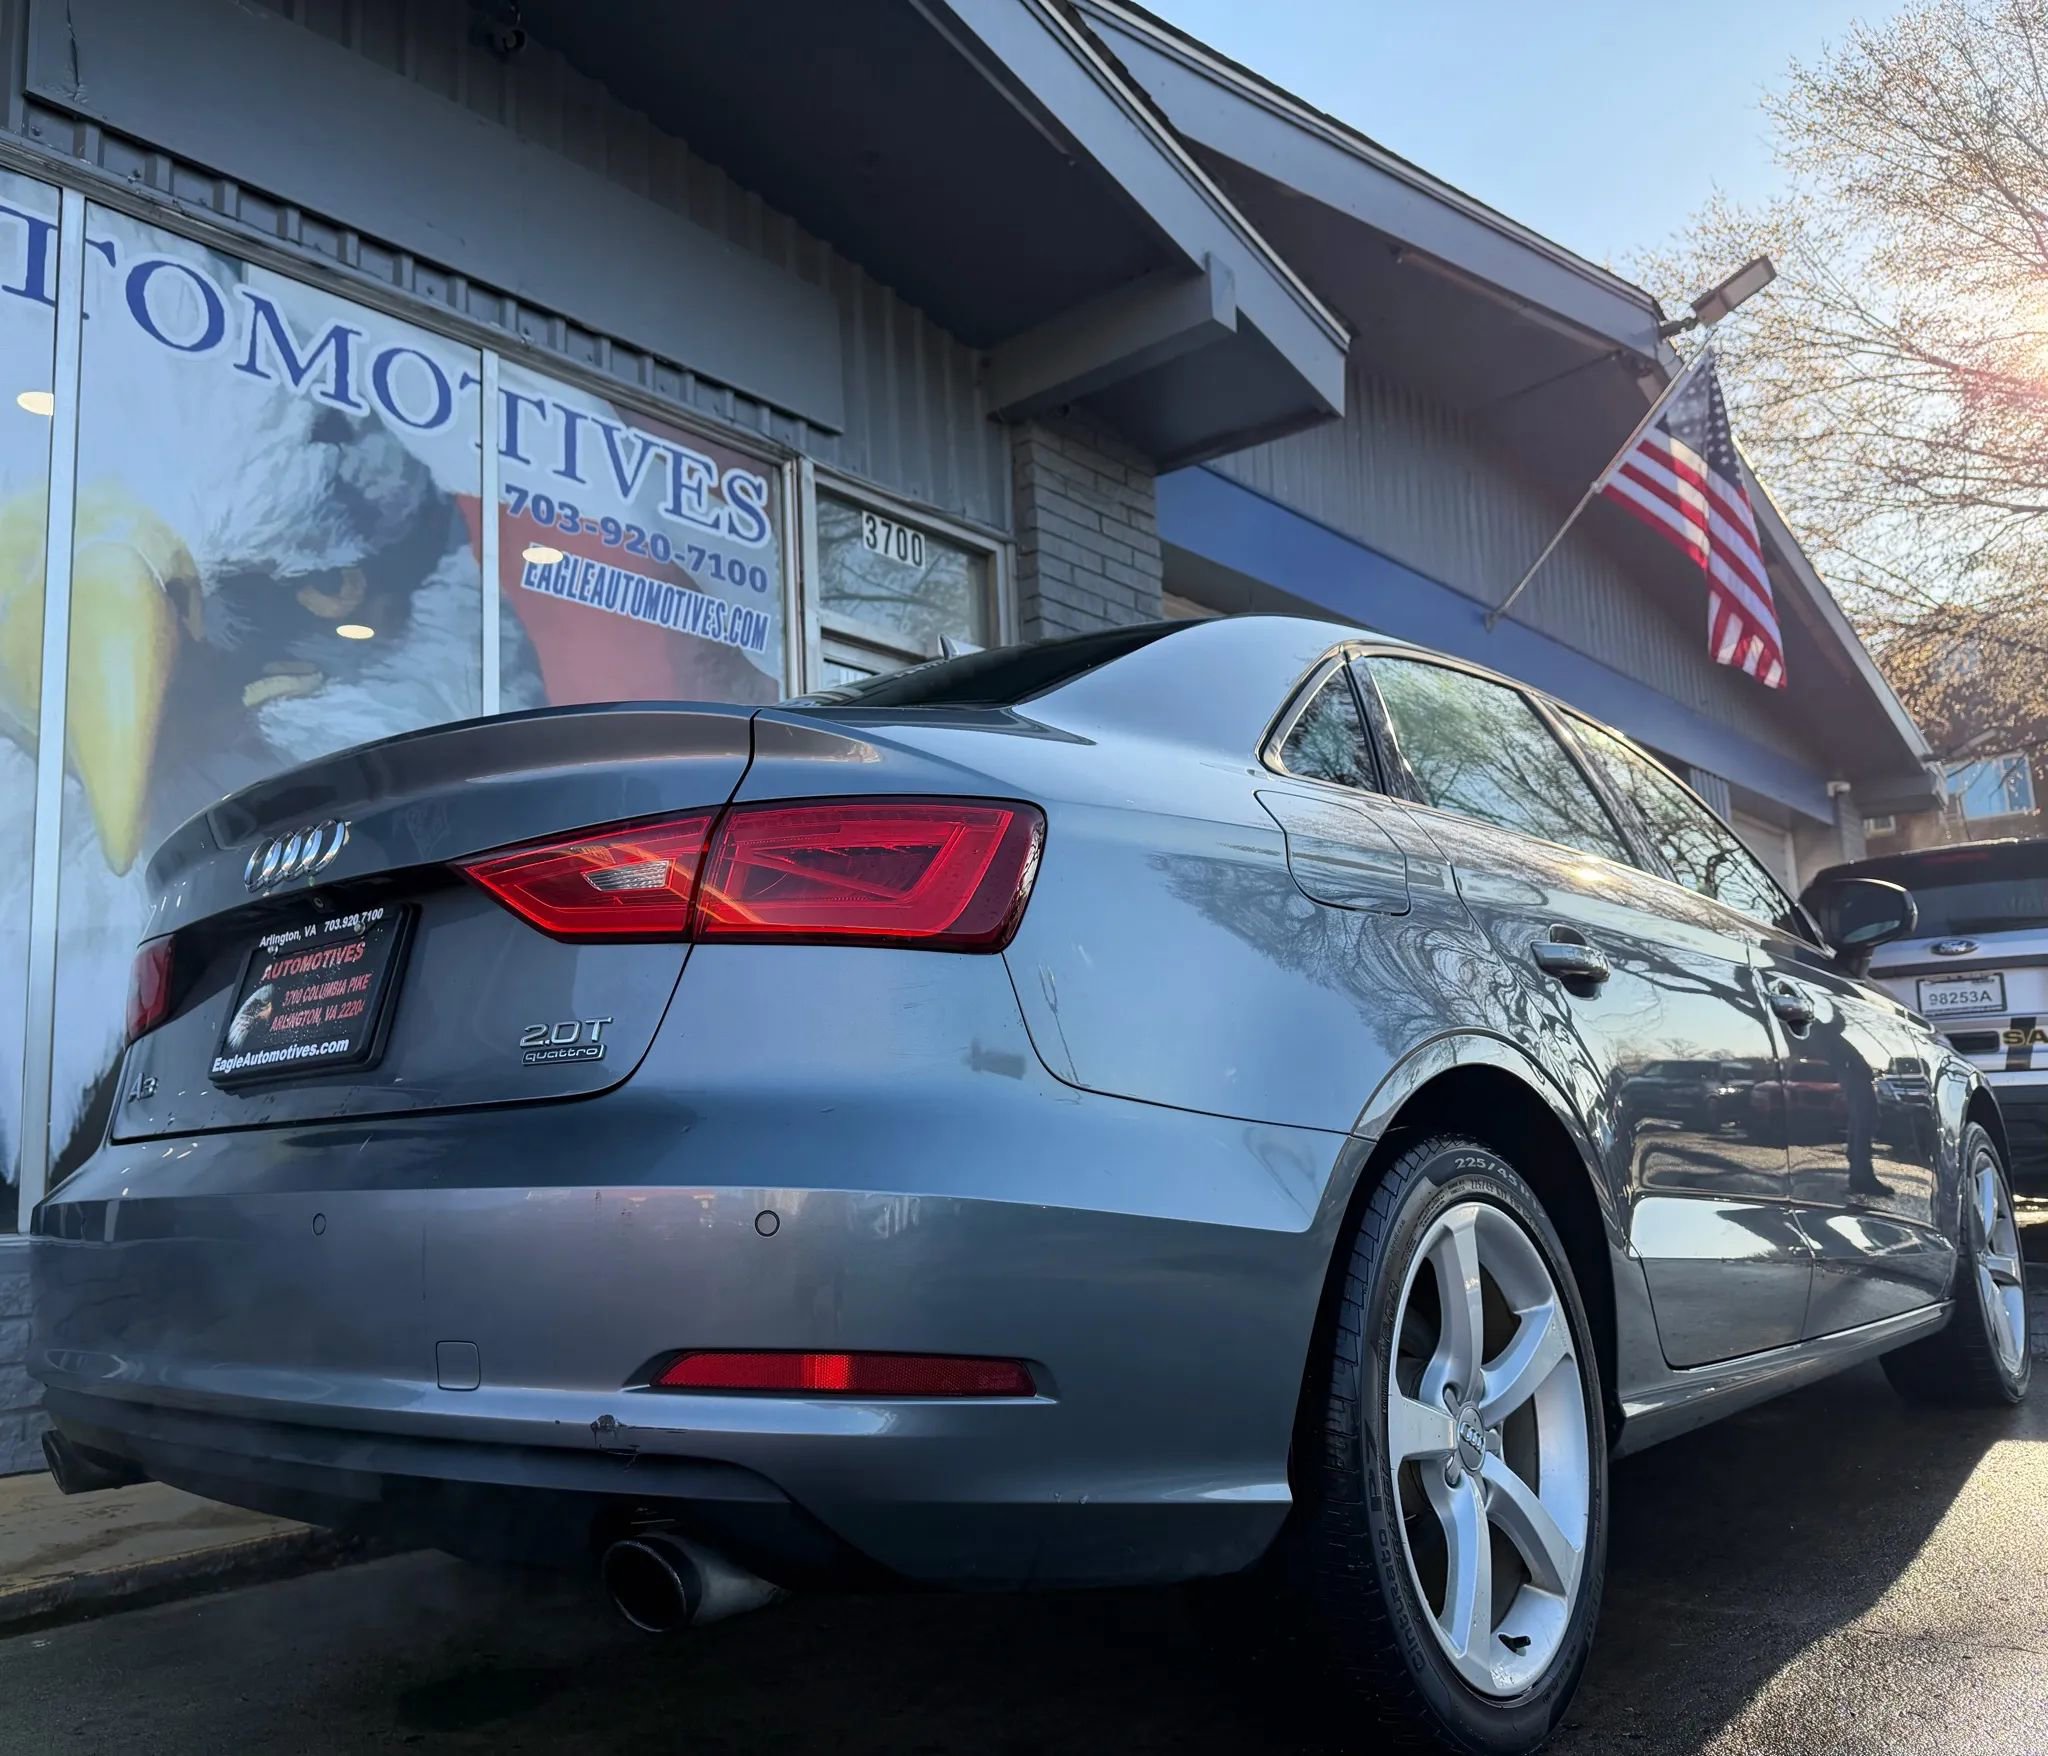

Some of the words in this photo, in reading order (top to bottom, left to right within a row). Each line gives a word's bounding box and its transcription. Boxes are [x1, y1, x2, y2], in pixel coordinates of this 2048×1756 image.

[504, 483, 769, 593] 703-920-7100
[865, 514, 922, 567] 3700
[523, 545, 769, 651] EAGLEAUTOMOTIVES.COM
[258, 930, 302, 948] Arlington,
[304, 924, 317, 938] VA
[323, 908, 384, 933] 703.920.7100
[260, 942, 366, 981] AUTOMOTIVES
[303, 978, 347, 1004] COLUMBIA
[347, 973, 373, 993] PIKE
[1928, 990, 1993, 1005] 98253A
[270, 1008, 322, 1032] ARLINGTON,
[324, 1004, 339, 1022] VA
[520, 1017, 613, 1048] 2.0T
[212, 1039, 350, 1074] EagleAutomotives.com
[525, 1048, 598, 1062] quattro
